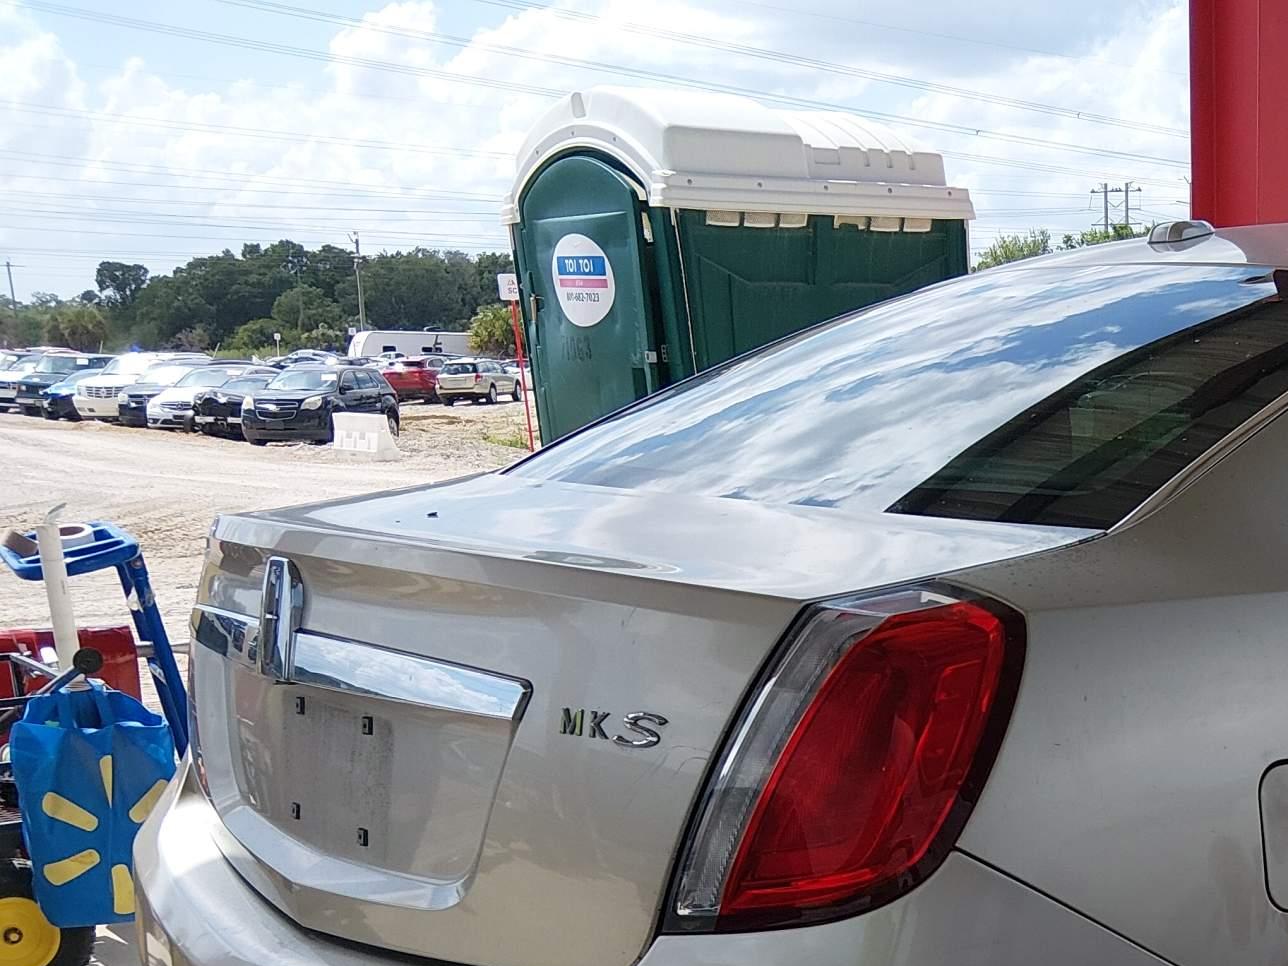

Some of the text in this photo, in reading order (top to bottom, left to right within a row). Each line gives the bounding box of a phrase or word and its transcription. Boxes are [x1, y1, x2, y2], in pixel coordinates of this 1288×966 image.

[564, 258, 594, 273] TOI TOI
[559, 707, 669, 748] MKS
